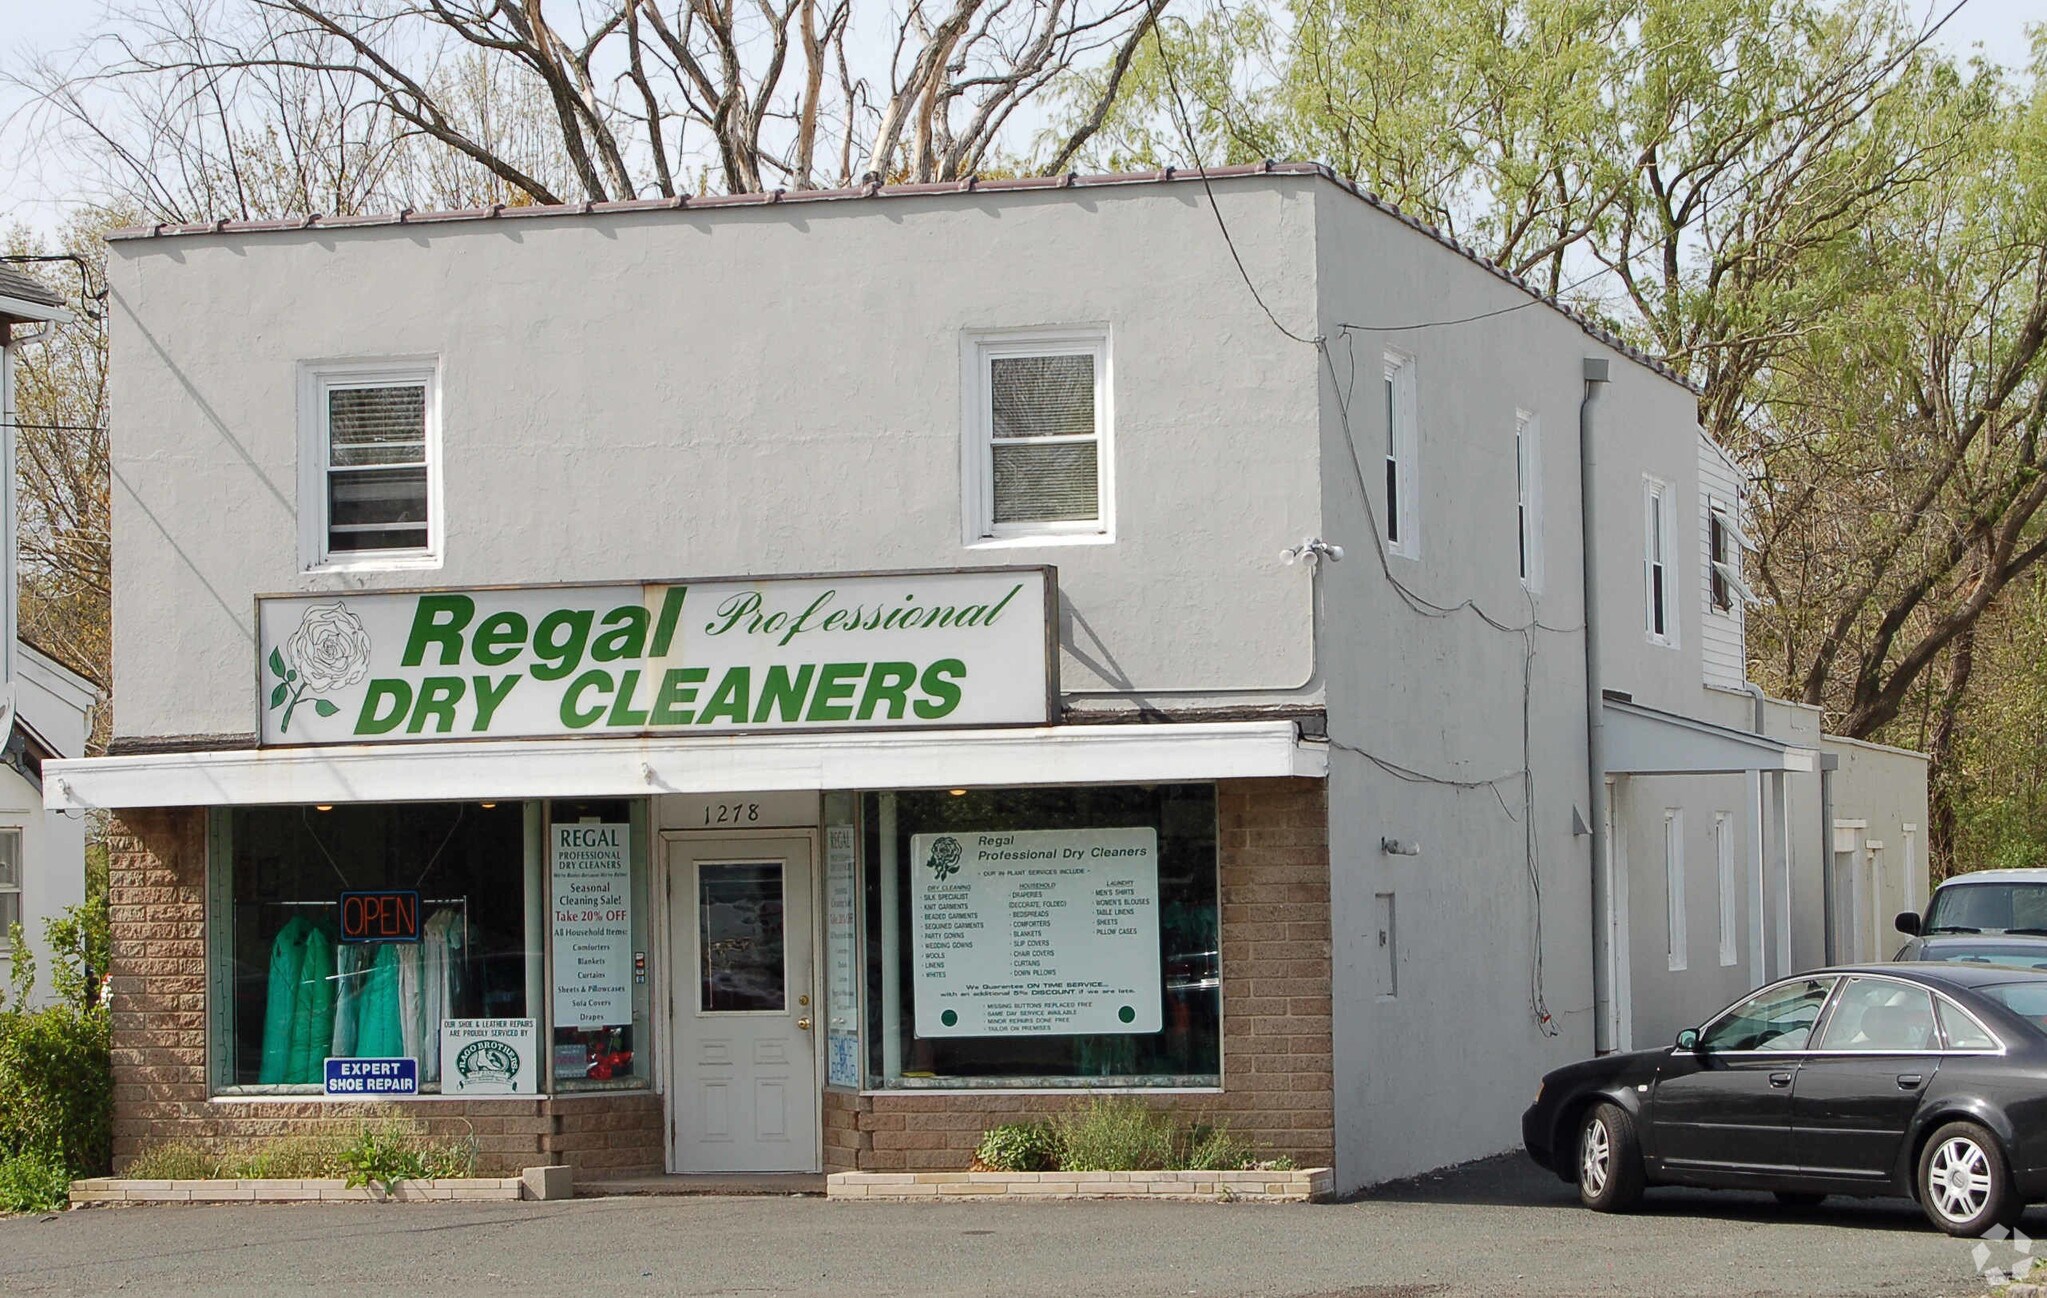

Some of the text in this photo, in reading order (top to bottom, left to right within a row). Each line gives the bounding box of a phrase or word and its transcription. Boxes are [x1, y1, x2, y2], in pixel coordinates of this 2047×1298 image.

[401, 583, 1025, 681] Regal Professional
[353, 658, 967, 735] DRY CLEANERS
[704, 803, 760, 824] 1278
[560, 829, 620, 848] REGAL
[830, 831, 851, 849] REGAL
[978, 836, 1014, 847] Regal
[558, 851, 621, 860] PROFESSIONAL
[978, 847, 1147, 861] Professional Dry Cleaners
[559, 860, 621, 869] DRY CLEANERS
[570, 882, 610, 893] Seasonal
[559, 894, 622, 907] Cleaning Sale!
[344, 897, 414, 934] OPEN
[555, 909, 627, 921] Take 20% OFF
[554, 928, 564, 936] All
[565, 928, 605, 936] Household
[572, 943, 610, 951] Comforters
[577, 957, 606, 965] Blankets
[577, 971, 606, 979] Curtains
[557, 985, 580, 993] Sheets
[588, 999, 611, 1007] Covers
[580, 1013, 604, 1021] Drapes
[444, 1020, 534, 1028] OUR SHOE & LEATHER REPAIRS
[449, 1029, 528, 1037] ARE PROUDLY SERVICED BY
[477, 1040, 519, 1069] BROTHERS
[341, 1062, 401, 1076] EXPERT
[329, 1077, 413, 1091] SHOE REPAIR
